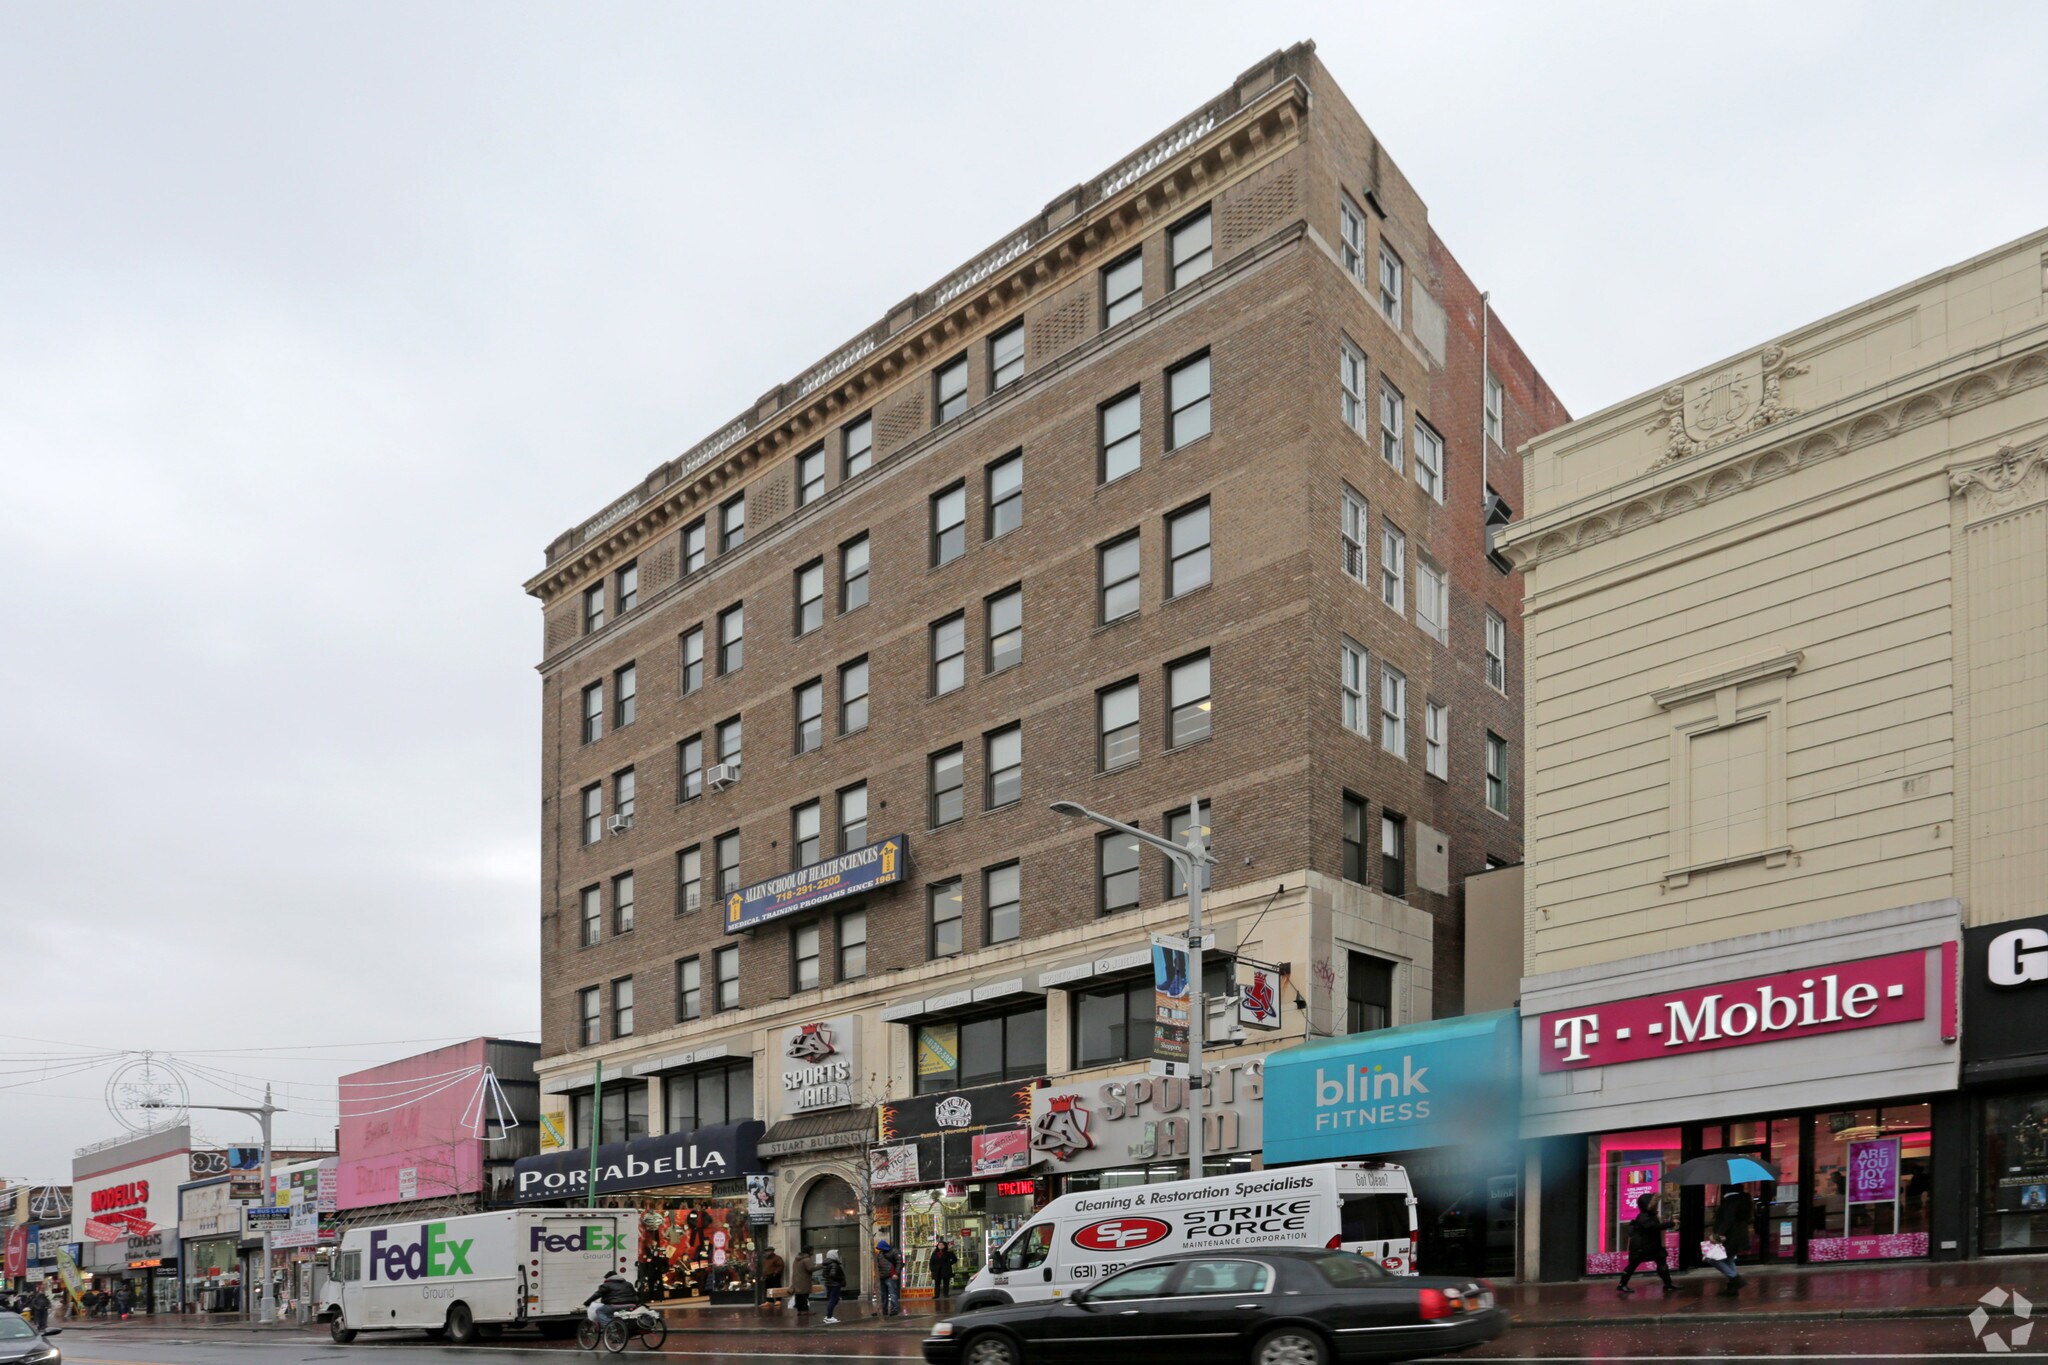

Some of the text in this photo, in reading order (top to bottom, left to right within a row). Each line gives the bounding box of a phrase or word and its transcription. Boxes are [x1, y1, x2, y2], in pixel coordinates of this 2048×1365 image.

[744, 882, 767, 904] ALLEN
[767, 873, 797, 897] SCHOOL
[797, 870, 809, 886] OF
[809, 858, 840, 883] HEALTH
[839, 846, 878, 873] SCIENCES
[776, 874, 840, 903] 718-291-2200
[727, 915, 760, 931] MEDICAL
[761, 904, 799, 920] TRAINING
[799, 888, 845, 909] PROGRAMS
[847, 881, 874, 893] SINCE
[875, 872, 897, 886] 1961
[782, 1061, 850, 1091] SPORTS
[1316, 1055, 1430, 1107] blink
[797, 1085, 838, 1109] JAM
[1099, 1059, 1263, 1120] SPORTS
[1316, 1101, 1430, 1131] FITNESS
[771, 1132, 861, 1152] STUART BUILDING
[1128, 1110, 1240, 1158] JAM
[1858, 1157, 1889, 1170] YOU
[1859, 1147, 1889, 1159] ARE
[677, 1168, 726, 1179] SHOES
[1356, 1173, 1389, 1187] Got Clean?
[1858, 1168, 1886, 1180] JOY
[1858, 1178, 1886, 1190] US?
[91, 1180, 149, 1213] MODELL'S
[520, 1186, 586, 1198] MENSWEAR
[947, 1184, 966, 1195] ATM
[1074, 1176, 1314, 1213] Cleaning & Restoration Specialists
[1491, 1189, 1515, 1198] blink
[1183, 1200, 1311, 1225] STRIKE
[530, 1225, 627, 1253] FedEx
[1096, 1221, 1148, 1248] SF
[1187, 1216, 1305, 1240] FORCE
[127, 1233, 162, 1249] COHEN'S
[369, 1222, 475, 1281] FedEx
[1182, 1232, 1307, 1249] MAINTENANCE CORPORATION
[1070, 1265, 1097, 1280] (631)
[422, 1285, 455, 1299] Ground
